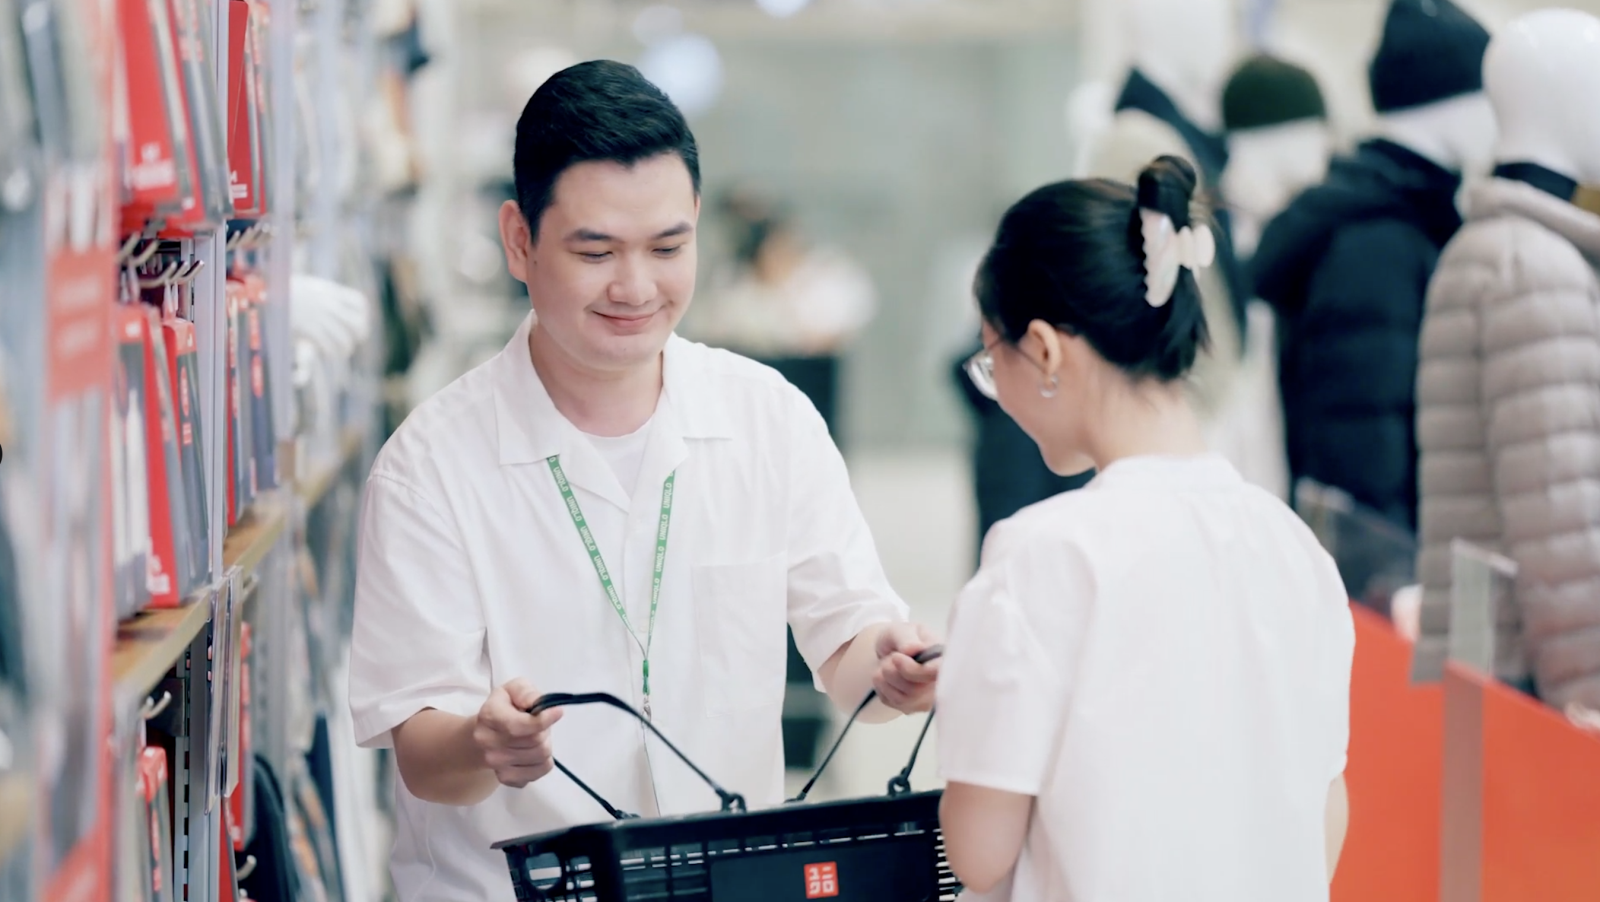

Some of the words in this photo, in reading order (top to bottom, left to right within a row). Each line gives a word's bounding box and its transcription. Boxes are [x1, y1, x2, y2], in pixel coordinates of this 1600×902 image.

[663, 482, 673, 509] UNIQLO
[553, 466, 569, 492] UNIQLO
[566, 495, 582, 522] UNIQLO
[580, 525, 596, 551] UNIQLO
[594, 555, 609, 580] UNIQLO
[607, 584, 622, 610] UNIQLO
[659, 513, 669, 541] UNIQLO
[655, 545, 665, 572] UNIQLO
